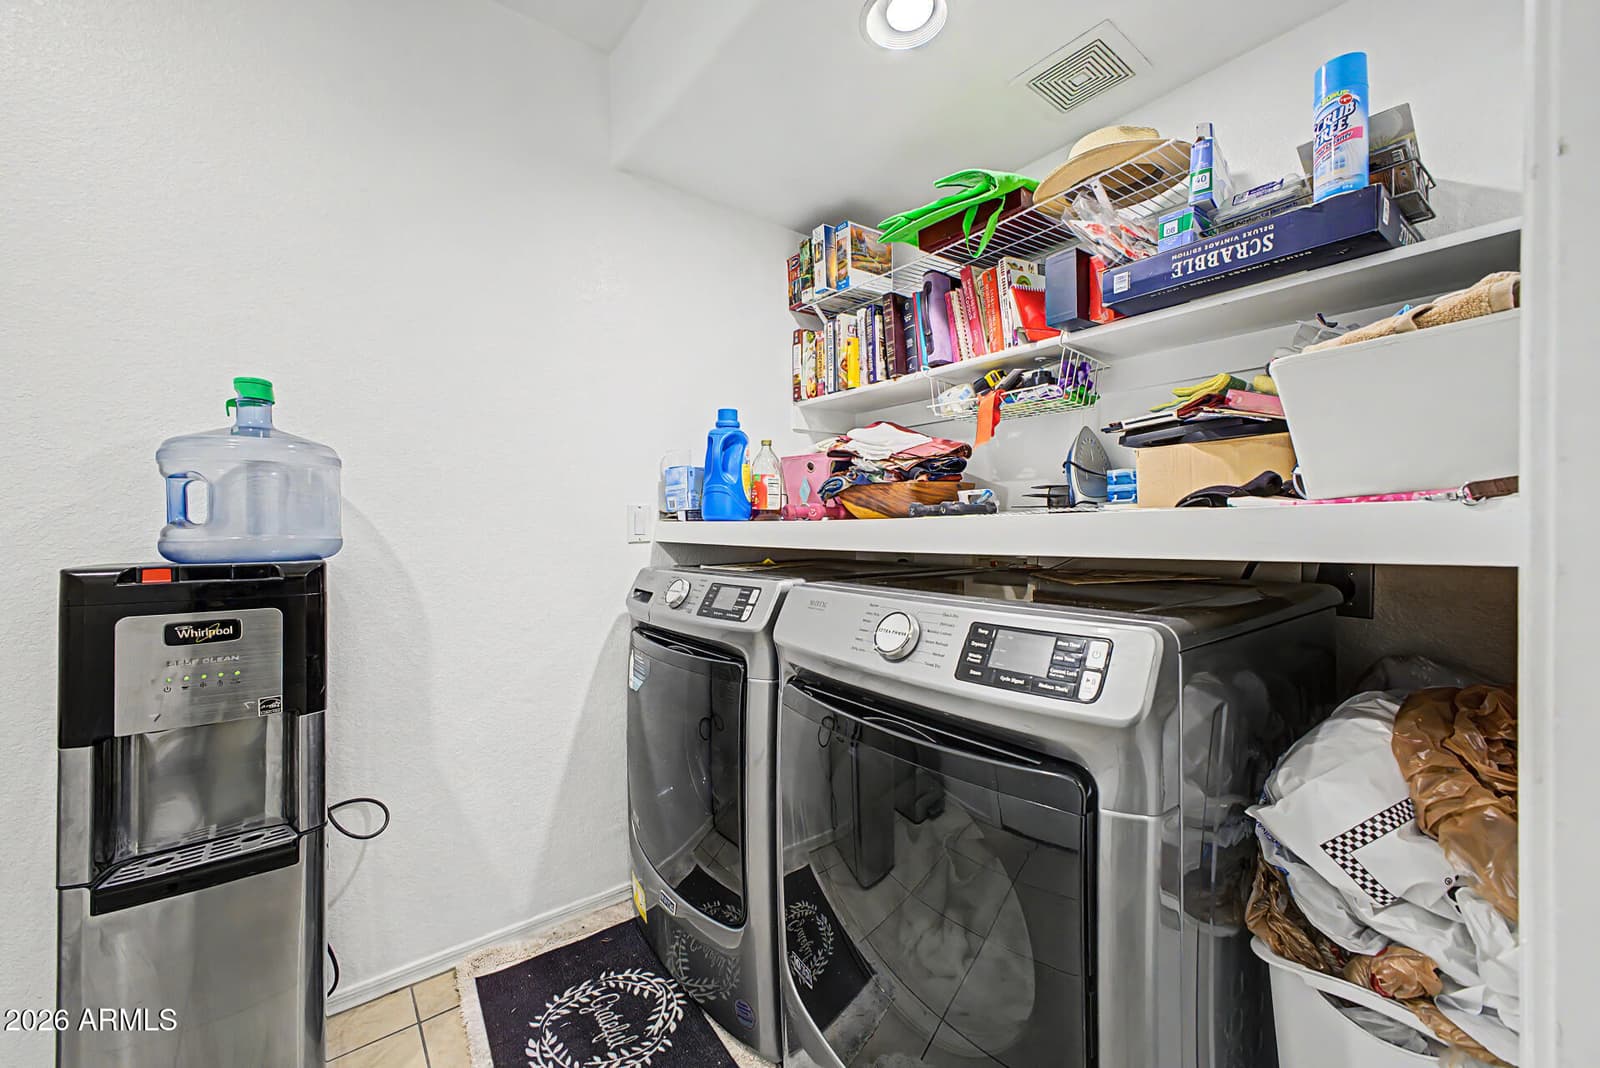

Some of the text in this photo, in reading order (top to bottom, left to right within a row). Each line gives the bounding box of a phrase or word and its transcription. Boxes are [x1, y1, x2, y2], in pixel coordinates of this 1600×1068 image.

[1170, 232, 1275, 279] SCRABBLE
[1171, 223, 1274, 260] DELUXE VINTAGE EDITION
[177, 625, 233, 639] Whirlpool
[202, 655, 240, 664] CLEAN
[579, 993, 639, 1050] Grateful
